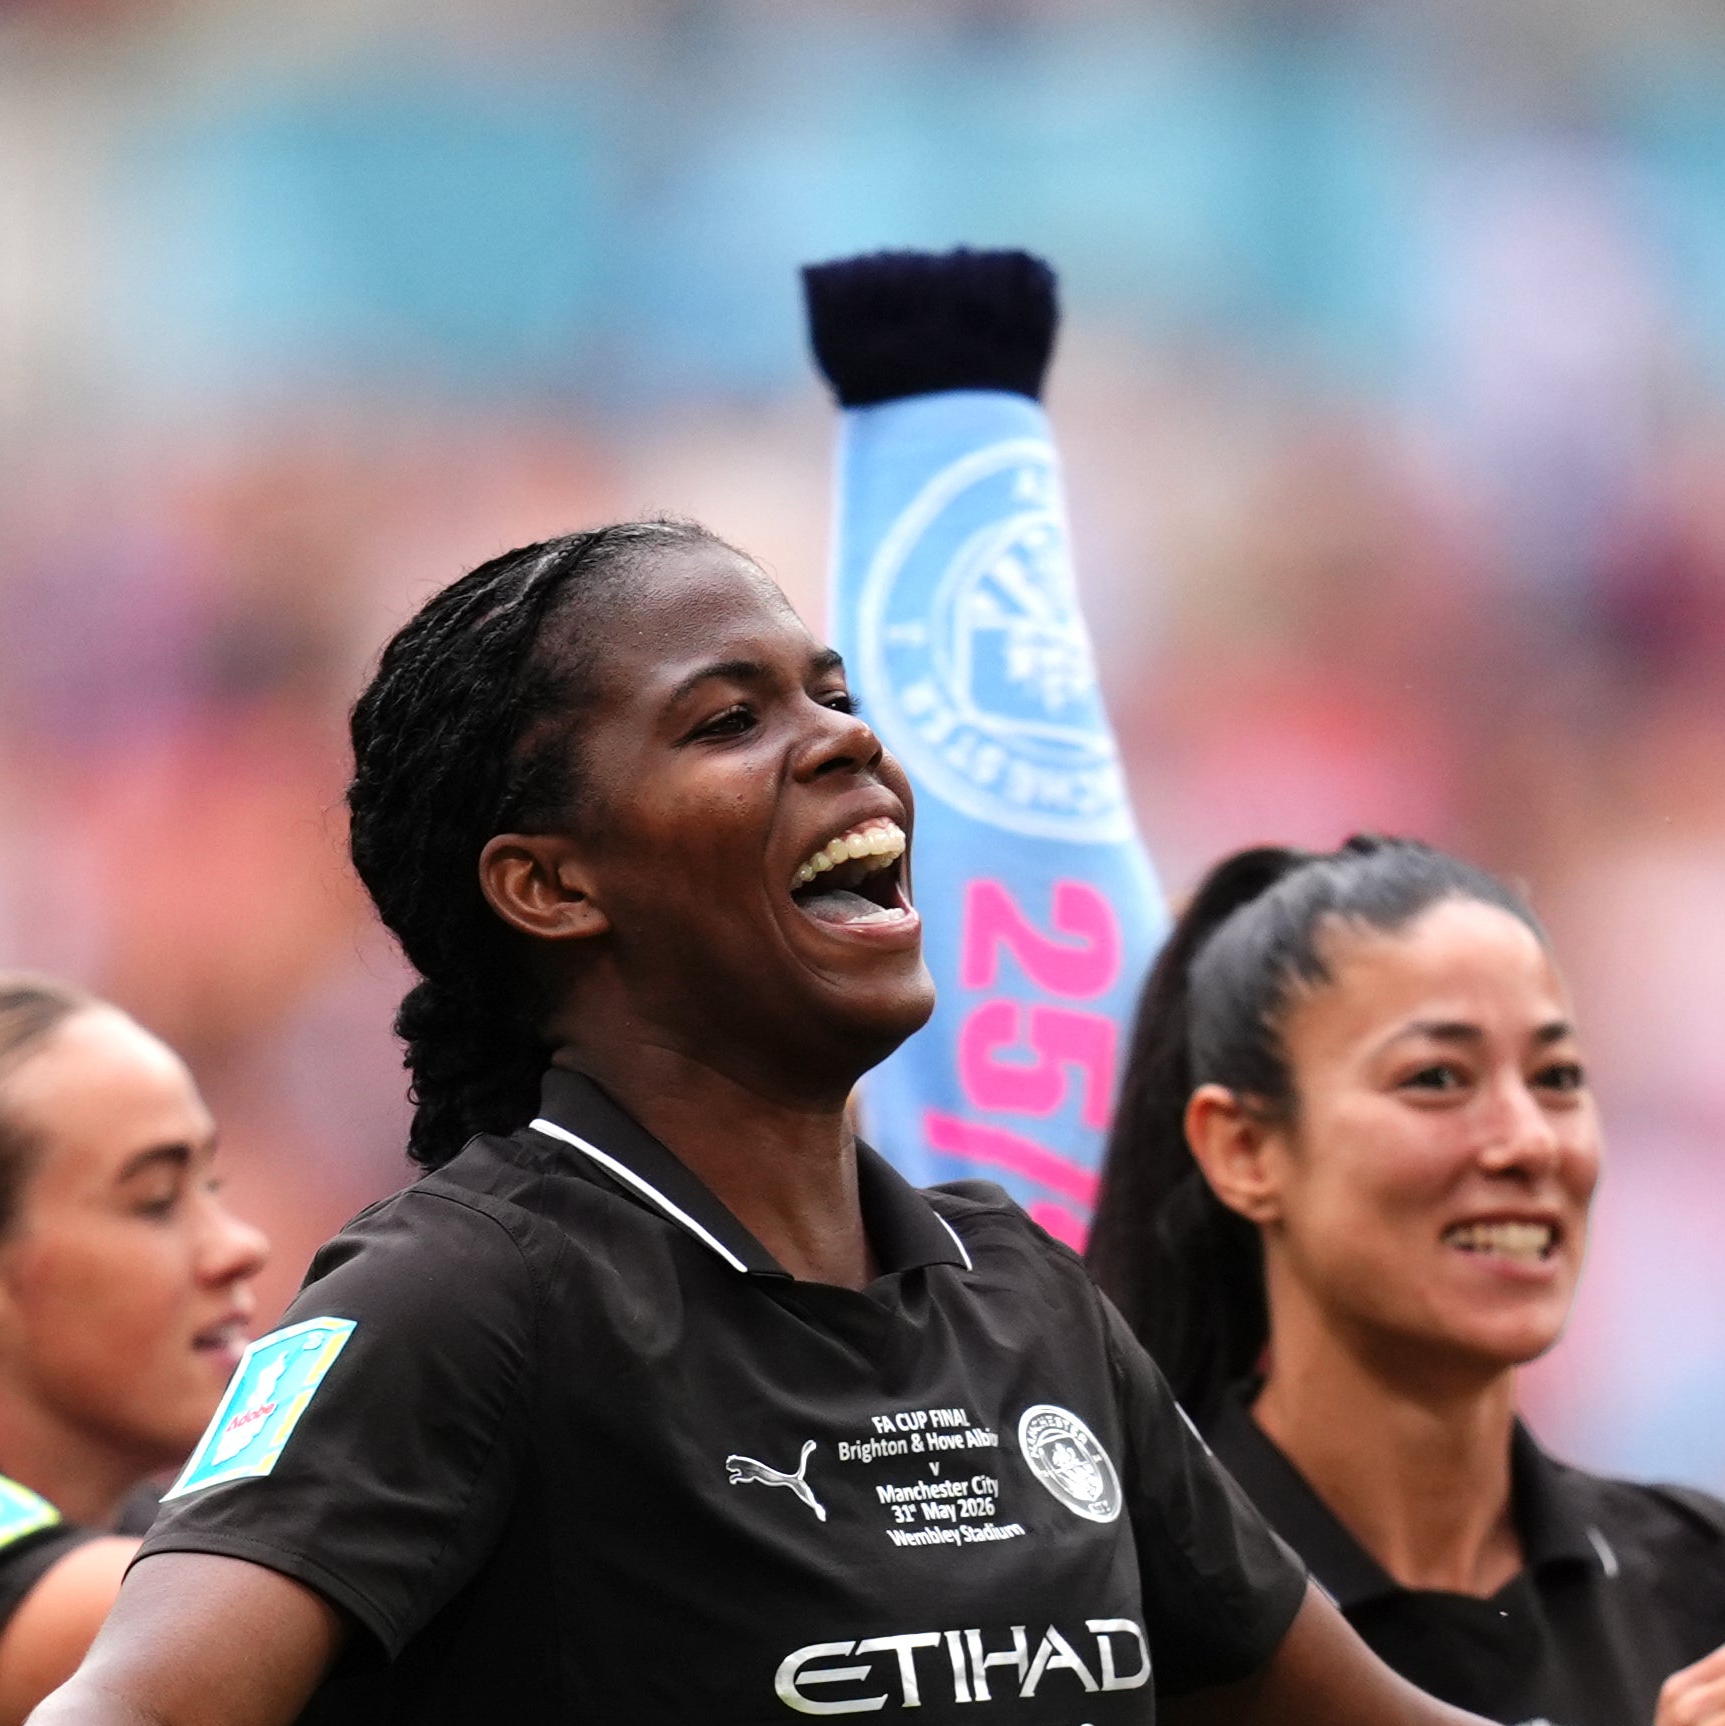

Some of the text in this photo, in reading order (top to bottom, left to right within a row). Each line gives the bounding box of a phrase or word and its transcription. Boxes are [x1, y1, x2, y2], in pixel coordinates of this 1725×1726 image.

[226, 1403, 275, 1433] Adobe
[871, 1408, 971, 1434] FA CUP FINAL
[838, 1438, 908, 1463] Brighton
[911, 1432, 925, 1453] &
[925, 1431, 965, 1451] Hove
[929, 1461, 940, 1477] v
[876, 1475, 999, 1504] Manchester City
[921, 1501, 957, 1523] May
[956, 1497, 996, 1518] 2026
[886, 1523, 1026, 1547] Wembley Stadium
[774, 1618, 1152, 1716] ETIHAD
